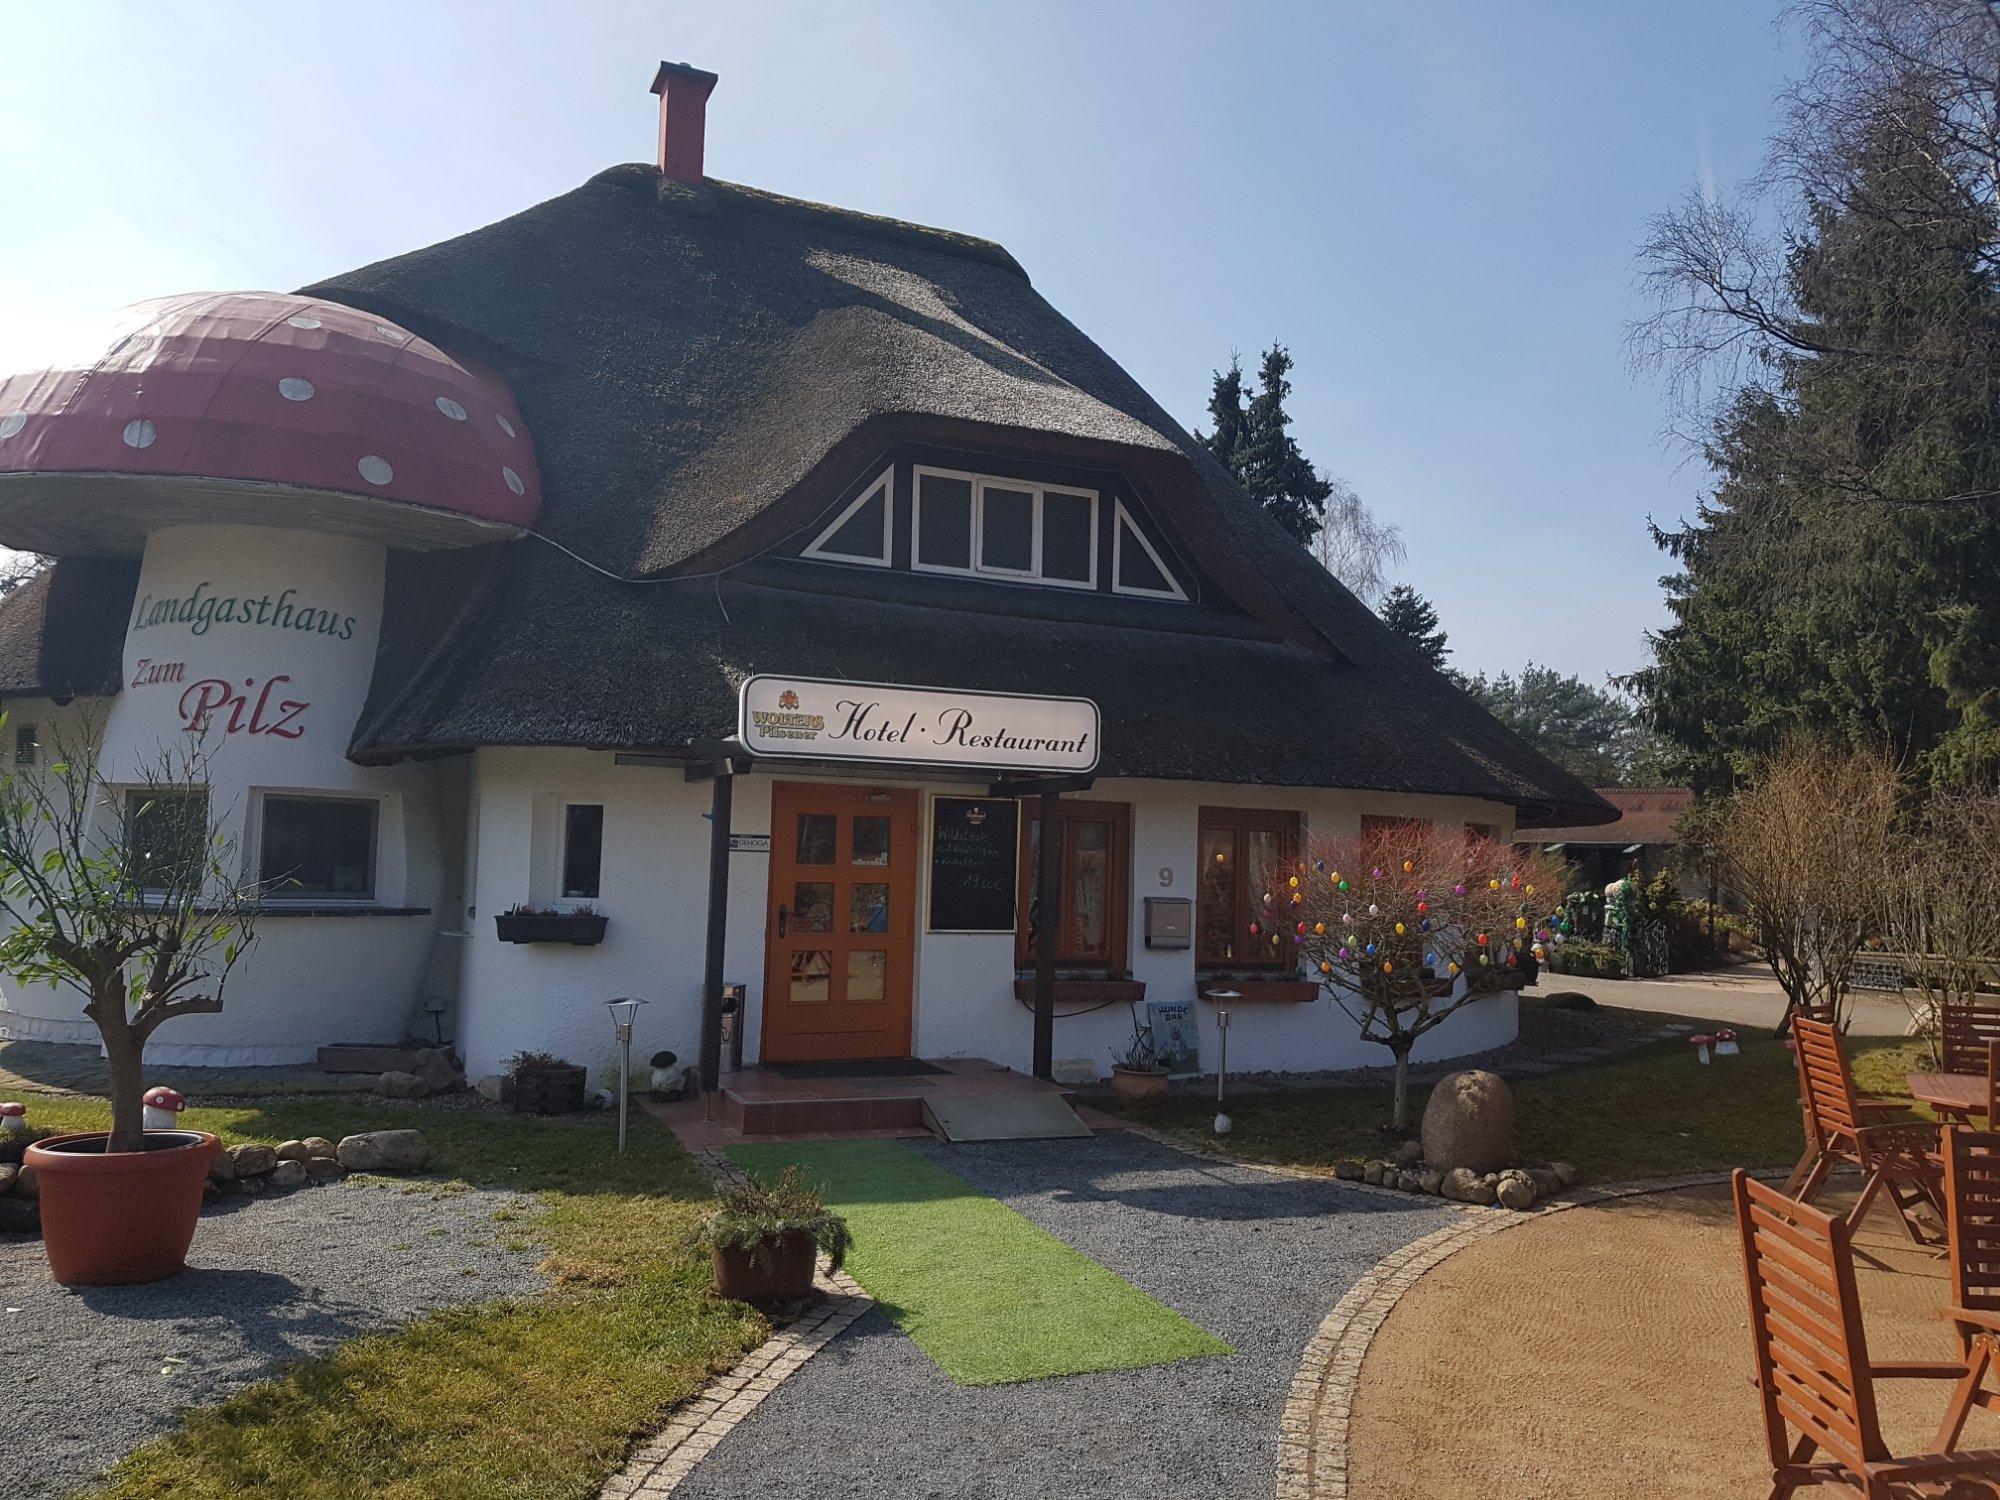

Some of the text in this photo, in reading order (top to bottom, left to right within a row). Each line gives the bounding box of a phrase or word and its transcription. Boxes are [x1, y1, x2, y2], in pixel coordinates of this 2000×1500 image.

[133, 582, 358, 640] Landgasthaus
[131, 658, 185, 689] Zum
[179, 675, 310, 738] Pilz
[752, 711, 824, 728] WOLTERS
[828, 700, 1088, 753] Hotel Restaurant
[759, 726, 817, 739] Pilsener
[1159, 867, 1174, 888] 9
[1158, 1006, 1189, 1015] HUNDE
[1165, 1013, 1183, 1021] BAR
